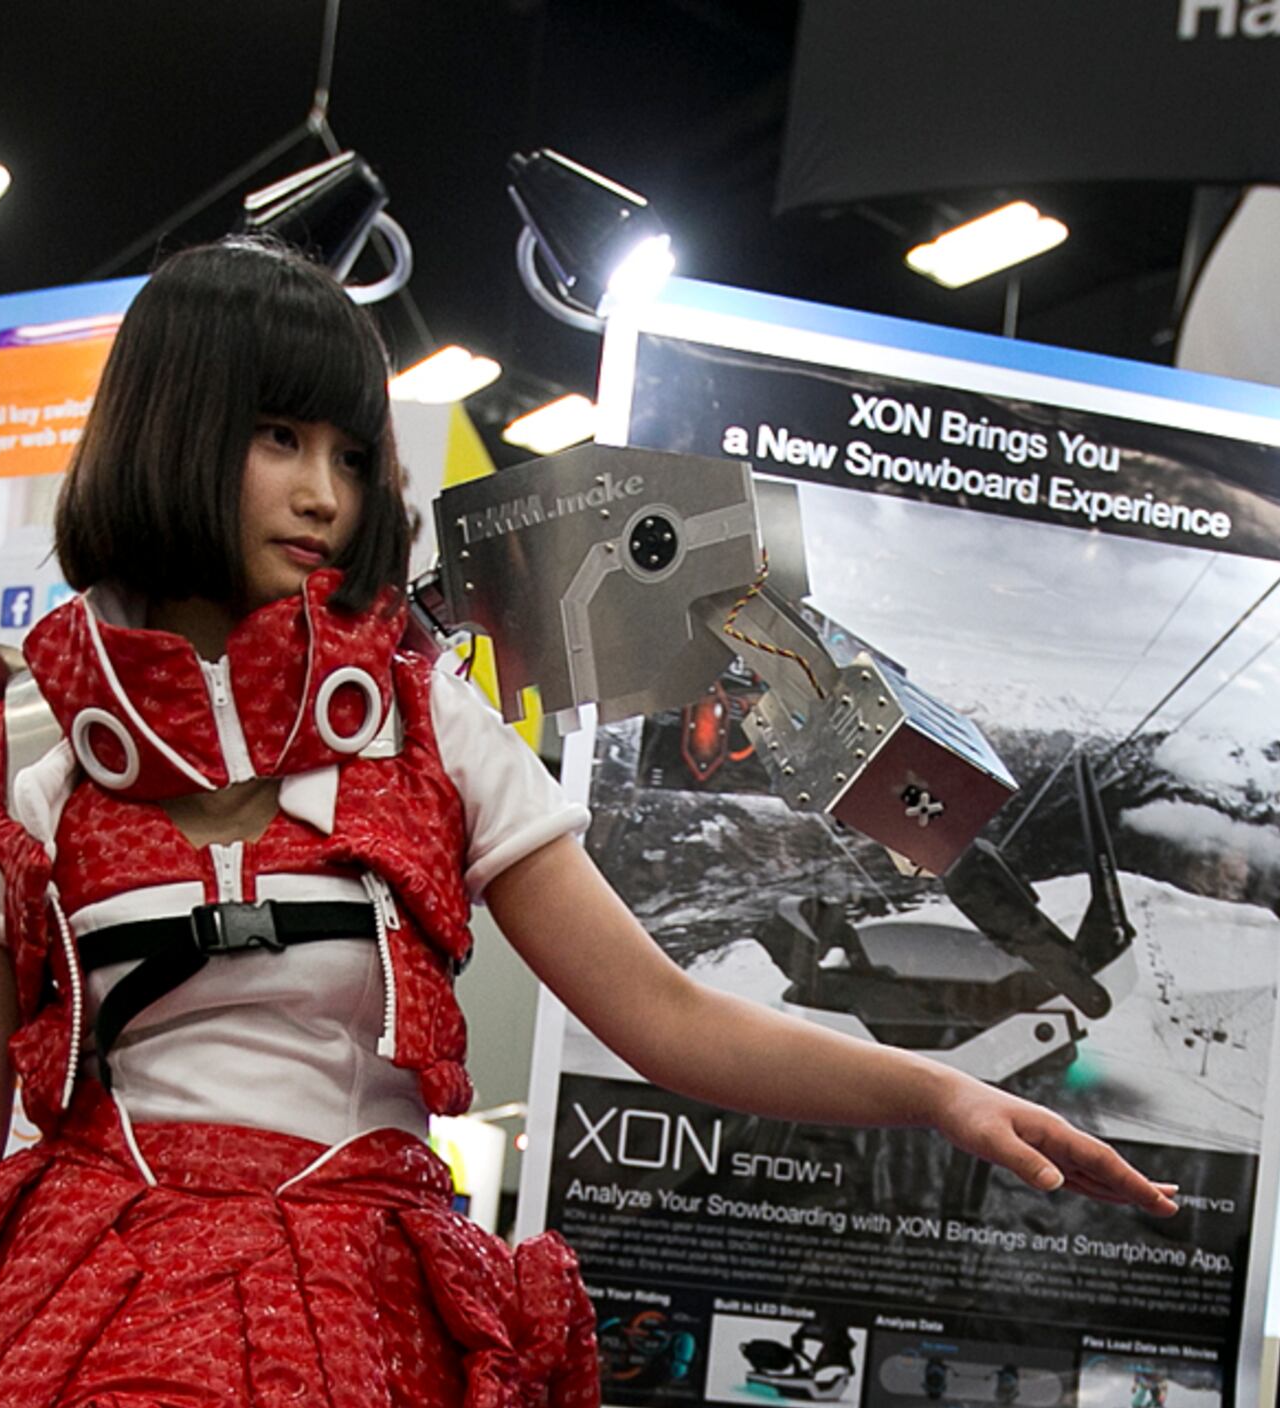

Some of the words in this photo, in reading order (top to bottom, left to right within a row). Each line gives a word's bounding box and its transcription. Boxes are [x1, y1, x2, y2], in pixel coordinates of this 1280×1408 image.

[849, 393, 932, 439] XON
[940, 412, 1048, 461] Brings
[1057, 433, 1121, 474] You
[723, 425, 749, 455] a
[757, 424, 838, 472] New
[845, 436, 1039, 504] Snowboard
[1048, 478, 1231, 539] Experience
[567, 1101, 722, 1176] XON
[566, 1178, 653, 1210] Analyze
[657, 1189, 702, 1213] Your
[706, 1194, 847, 1234] Snowboarding
[851, 1213, 893, 1234] with
[895, 1216, 942, 1240] XON
[946, 1220, 1027, 1251] Bindings
[1031, 1233, 1069, 1254] and
[1073, 1235, 1186, 1268] Smartphone
[1190, 1247, 1234, 1274] App.
